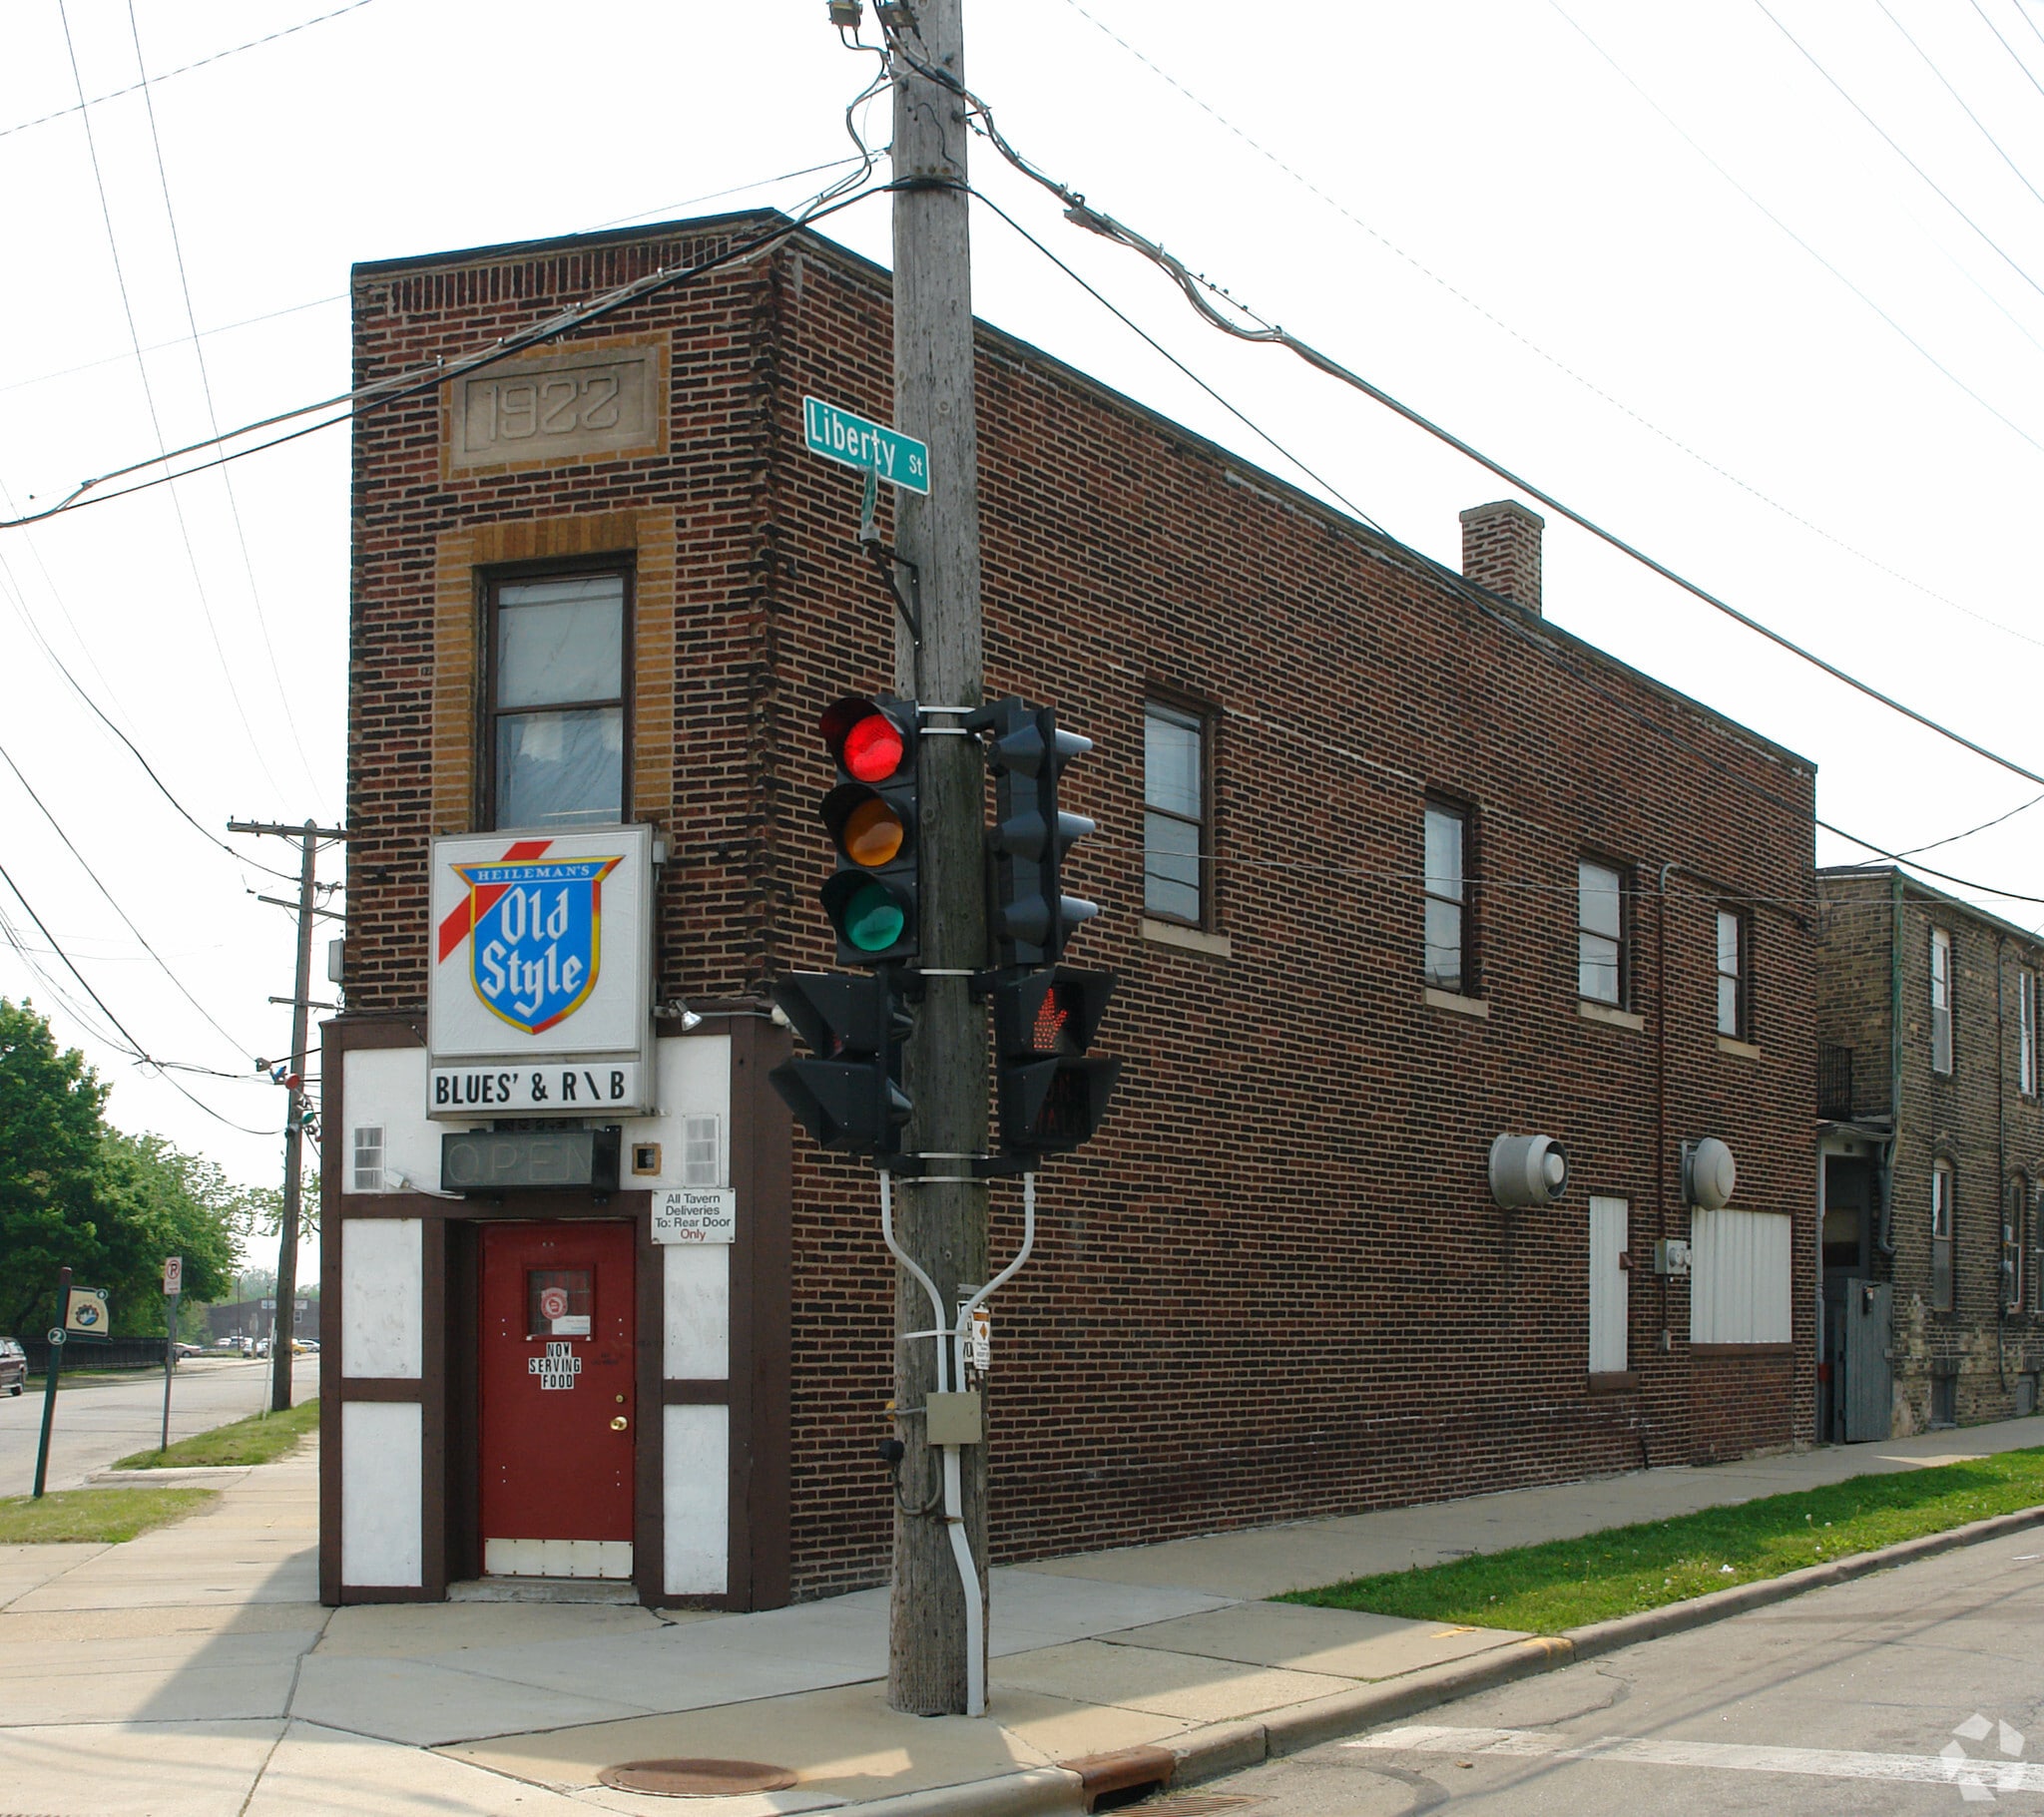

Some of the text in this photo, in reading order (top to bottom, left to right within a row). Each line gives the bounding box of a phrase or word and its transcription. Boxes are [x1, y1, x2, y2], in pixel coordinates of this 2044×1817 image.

[485, 370, 619, 442] 1922
[809, 402, 923, 478] Liberty St
[477, 864, 591, 882] HEILEMAN'S
[500, 886, 569, 946] Old
[480, 939, 583, 1019] Style
[435, 1073, 519, 1105] BLUES'
[531, 1072, 549, 1102] &
[667, 1192, 721, 1204] All Tavern
[666, 1204, 721, 1216] Deliveries
[655, 1216, 732, 1228] To: Rear Door
[680, 1228, 707, 1242] Only
[52, 1330, 62, 1342] 2
[547, 1343, 570, 1358] NOW
[529, 1358, 581, 1374] SERVING
[543, 1373, 573, 1389] FOOD
